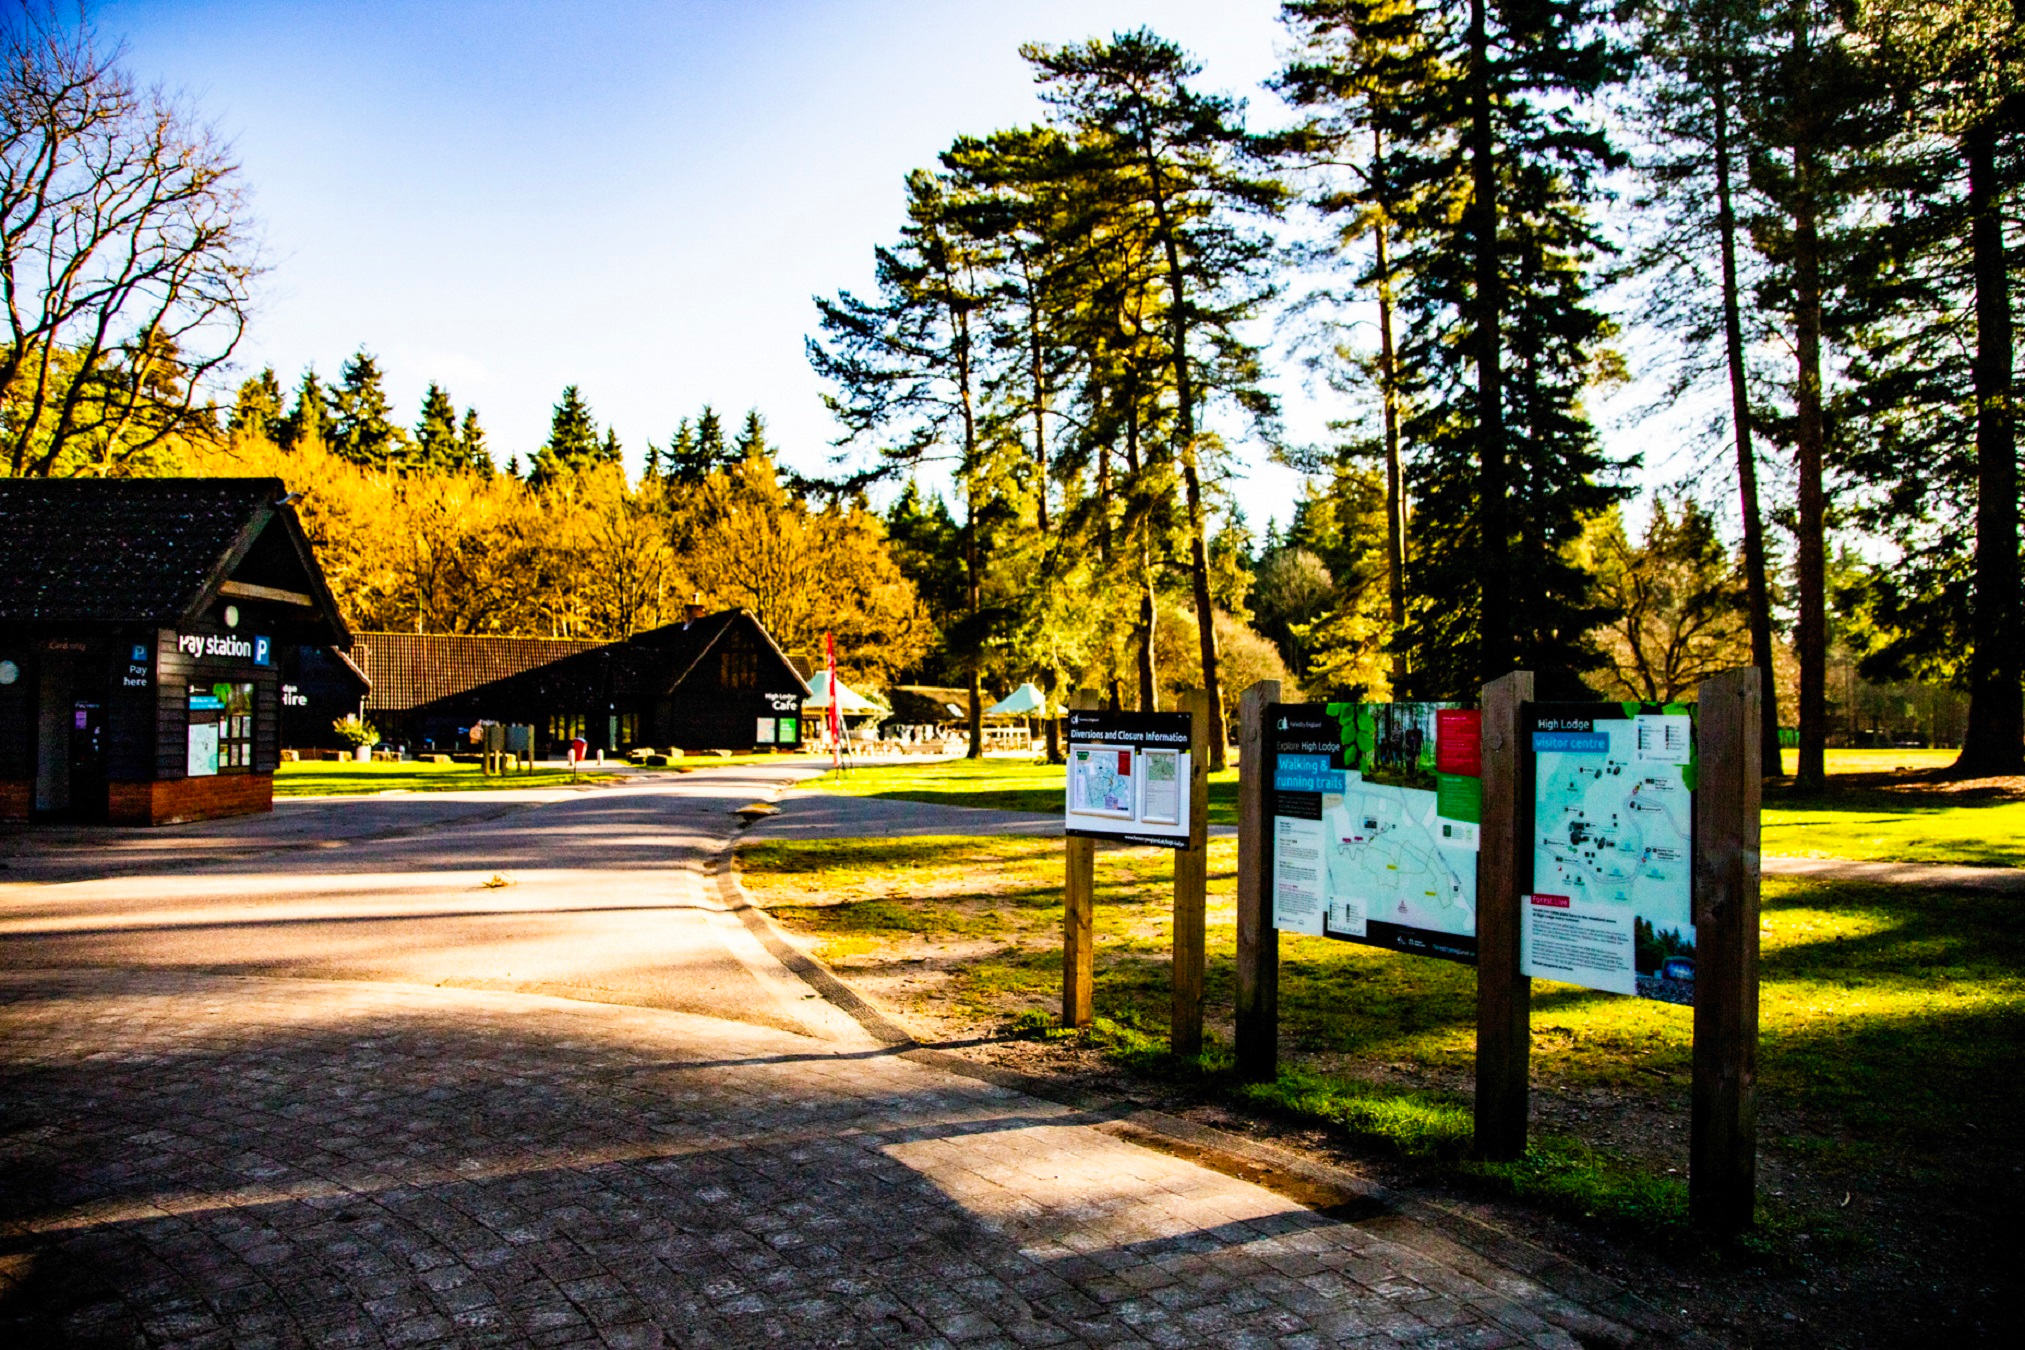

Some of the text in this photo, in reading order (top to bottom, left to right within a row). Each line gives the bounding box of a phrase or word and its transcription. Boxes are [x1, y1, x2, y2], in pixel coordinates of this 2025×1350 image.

[179, 634, 251, 658] Pay station
[256, 639, 267, 661] P
[129, 664, 148, 676] Pay
[123, 676, 148, 687] here
[1537, 717, 1590, 731] High Lodge
[1070, 729, 1188, 742] Diversions and Closure Information
[1276, 740, 1341, 753] Explore High Lodge
[1535, 736, 1606, 750] visitor centre
[1279, 757, 1328, 775] Walking &
[1276, 775, 1344, 791] running trails
[1532, 895, 1554, 906] Forest
